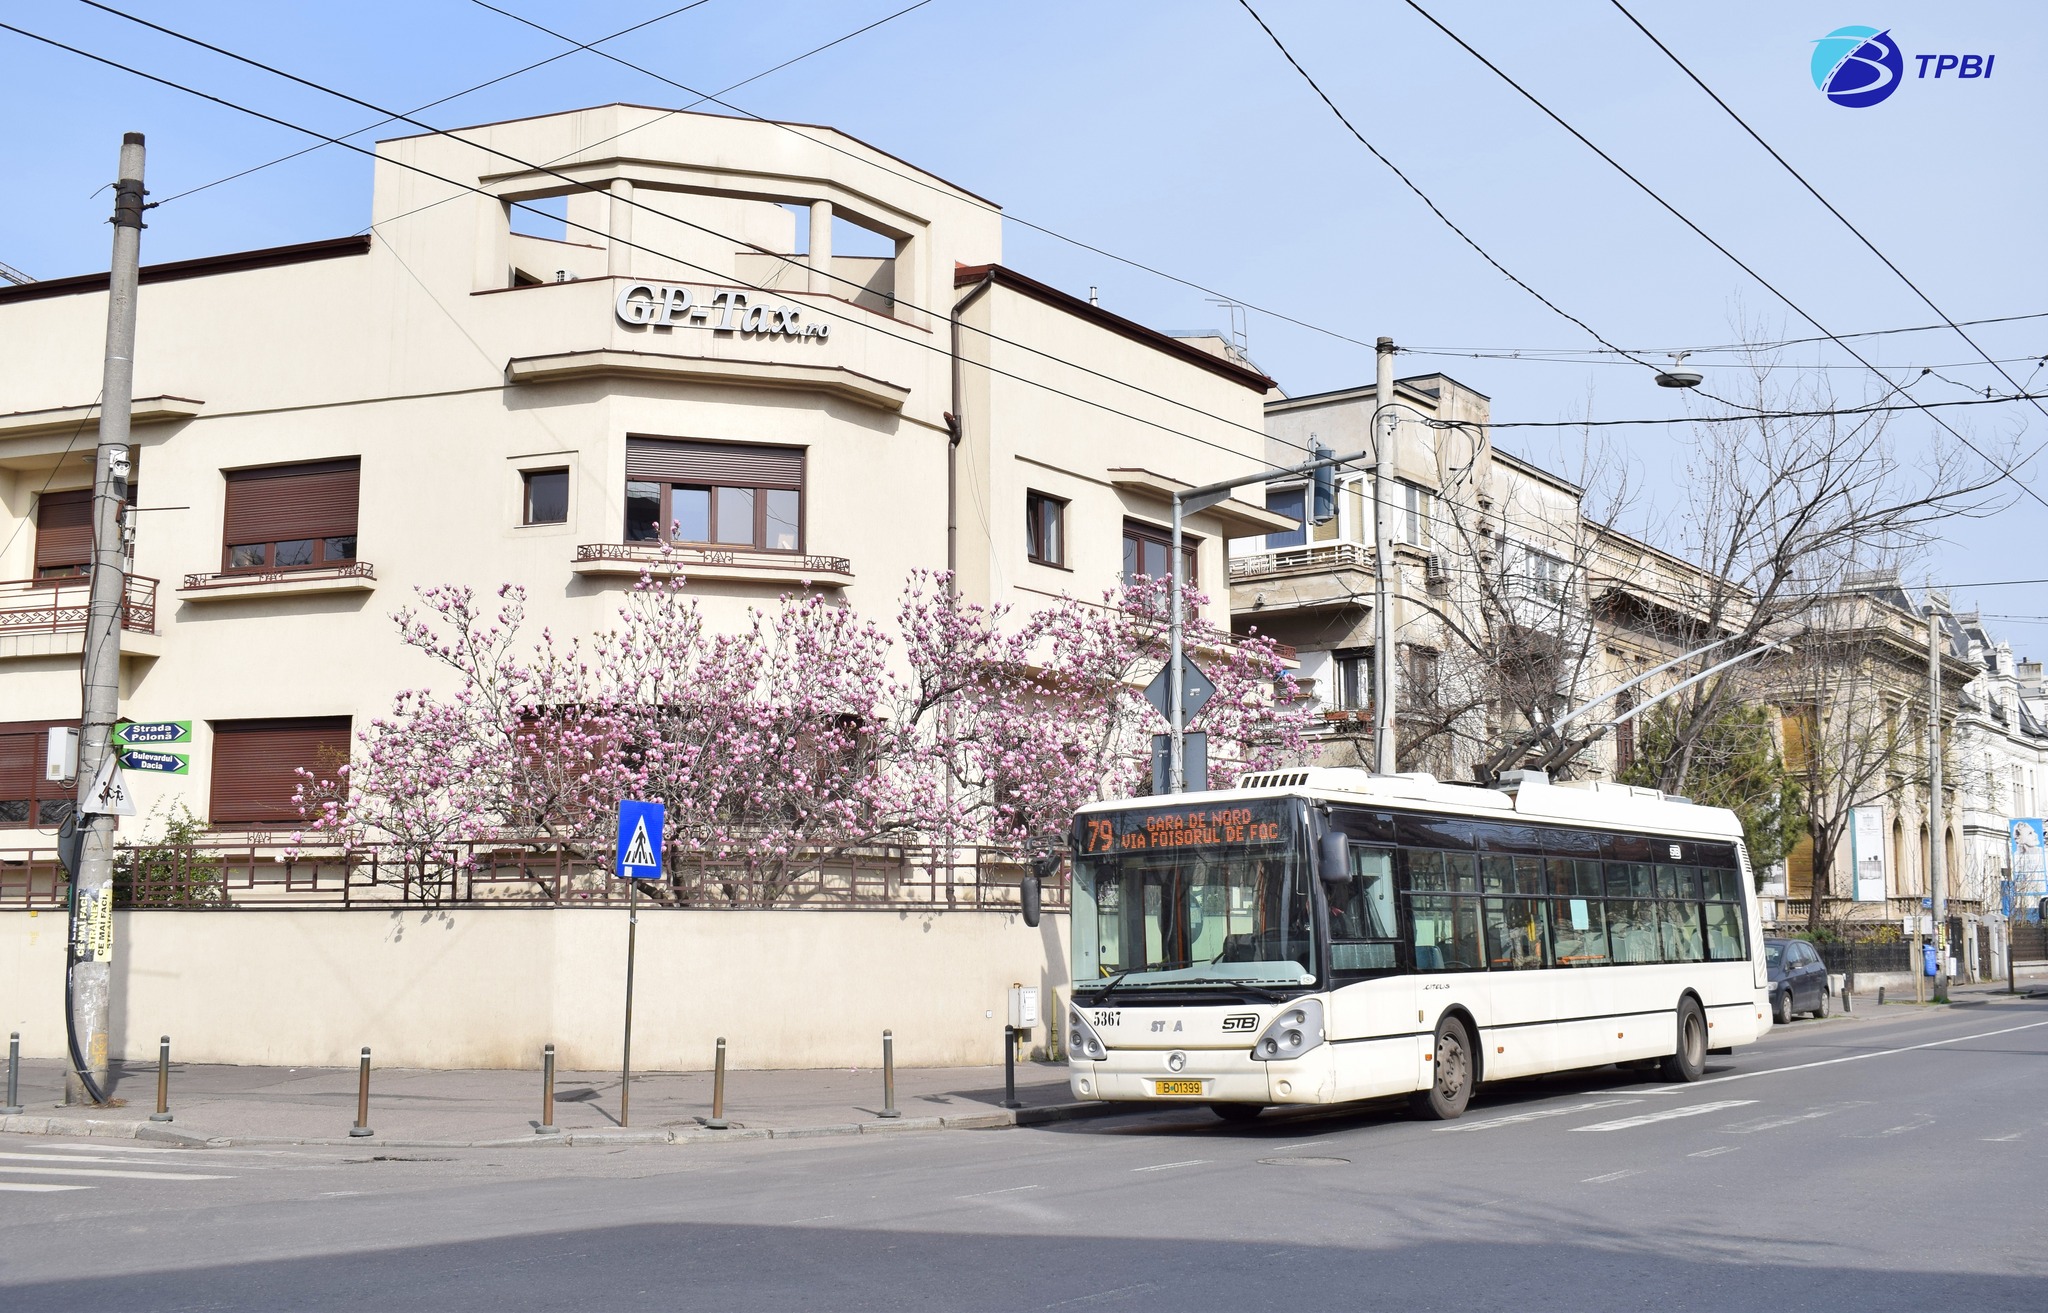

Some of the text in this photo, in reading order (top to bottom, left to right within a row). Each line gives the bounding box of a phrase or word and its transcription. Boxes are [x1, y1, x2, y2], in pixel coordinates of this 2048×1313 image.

[133, 724, 172, 733] Strada
[131, 732, 172, 741] Polonă
[132, 752, 173, 762] Bulevardul
[141, 761, 163, 769] Dacia
[1146, 808, 1251, 832] GARA DE NORD
[1087, 819, 1113, 852] 79
[1121, 823, 1278, 849] VIA FOISORUL DE FOC
[98, 942, 105, 956] CE
[1093, 1011, 1121, 1027] 5367
[1222, 1016, 1256, 1030] STB
